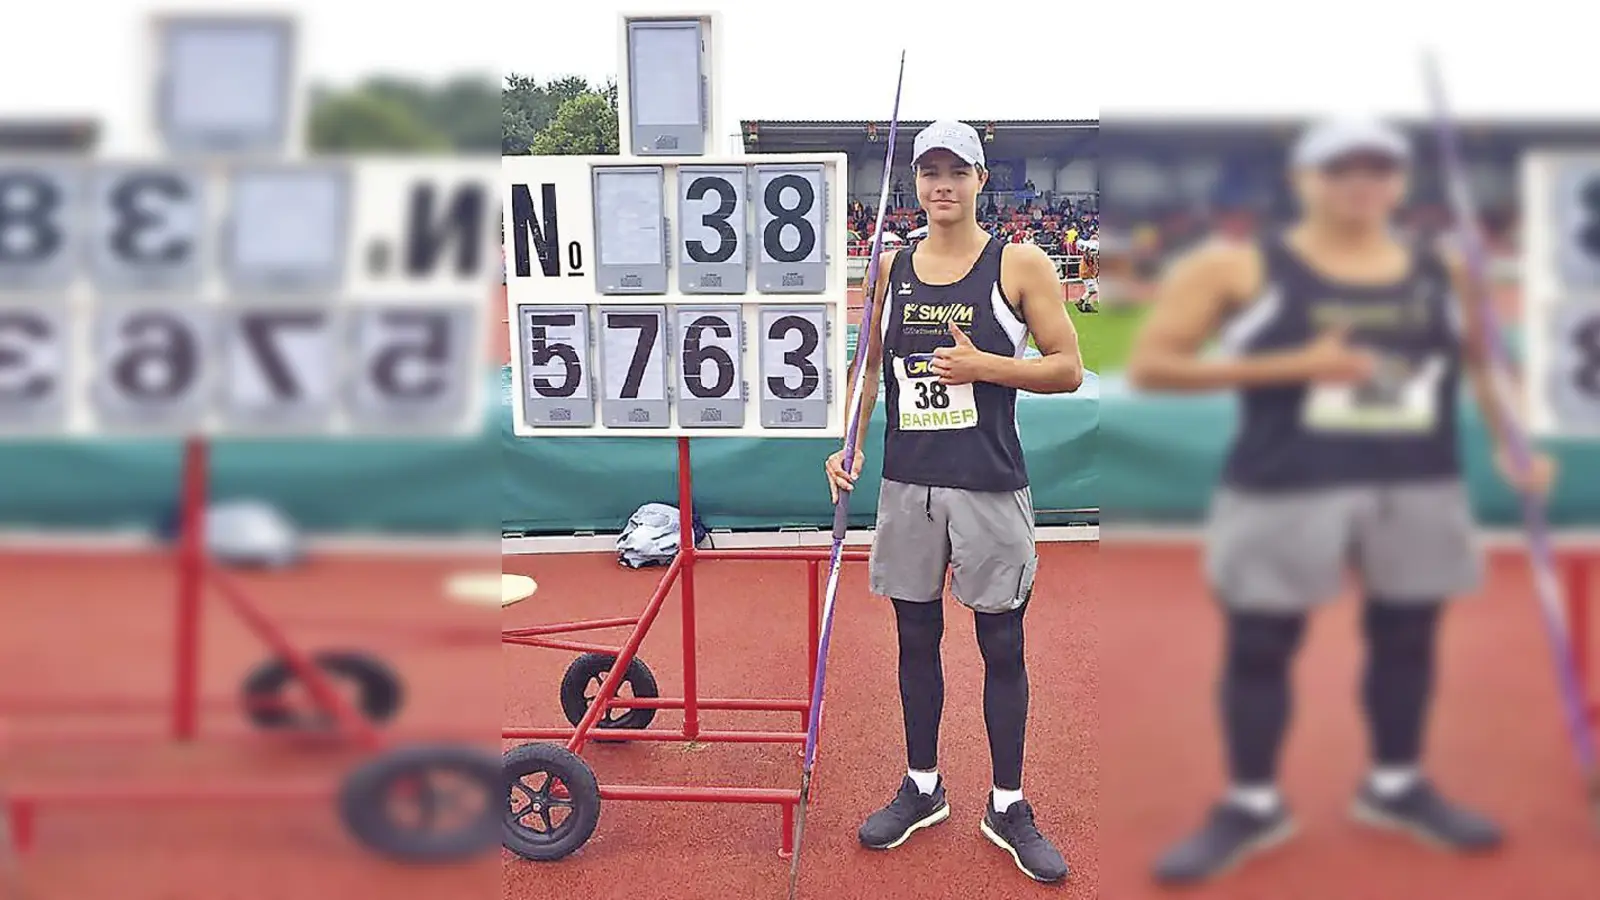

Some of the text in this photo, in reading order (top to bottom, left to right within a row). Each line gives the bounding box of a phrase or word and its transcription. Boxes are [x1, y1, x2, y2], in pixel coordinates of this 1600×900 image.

[685, 174, 816, 263] 38
[914, 381, 950, 410] 38
[902, 409, 975, 427] BARMER
